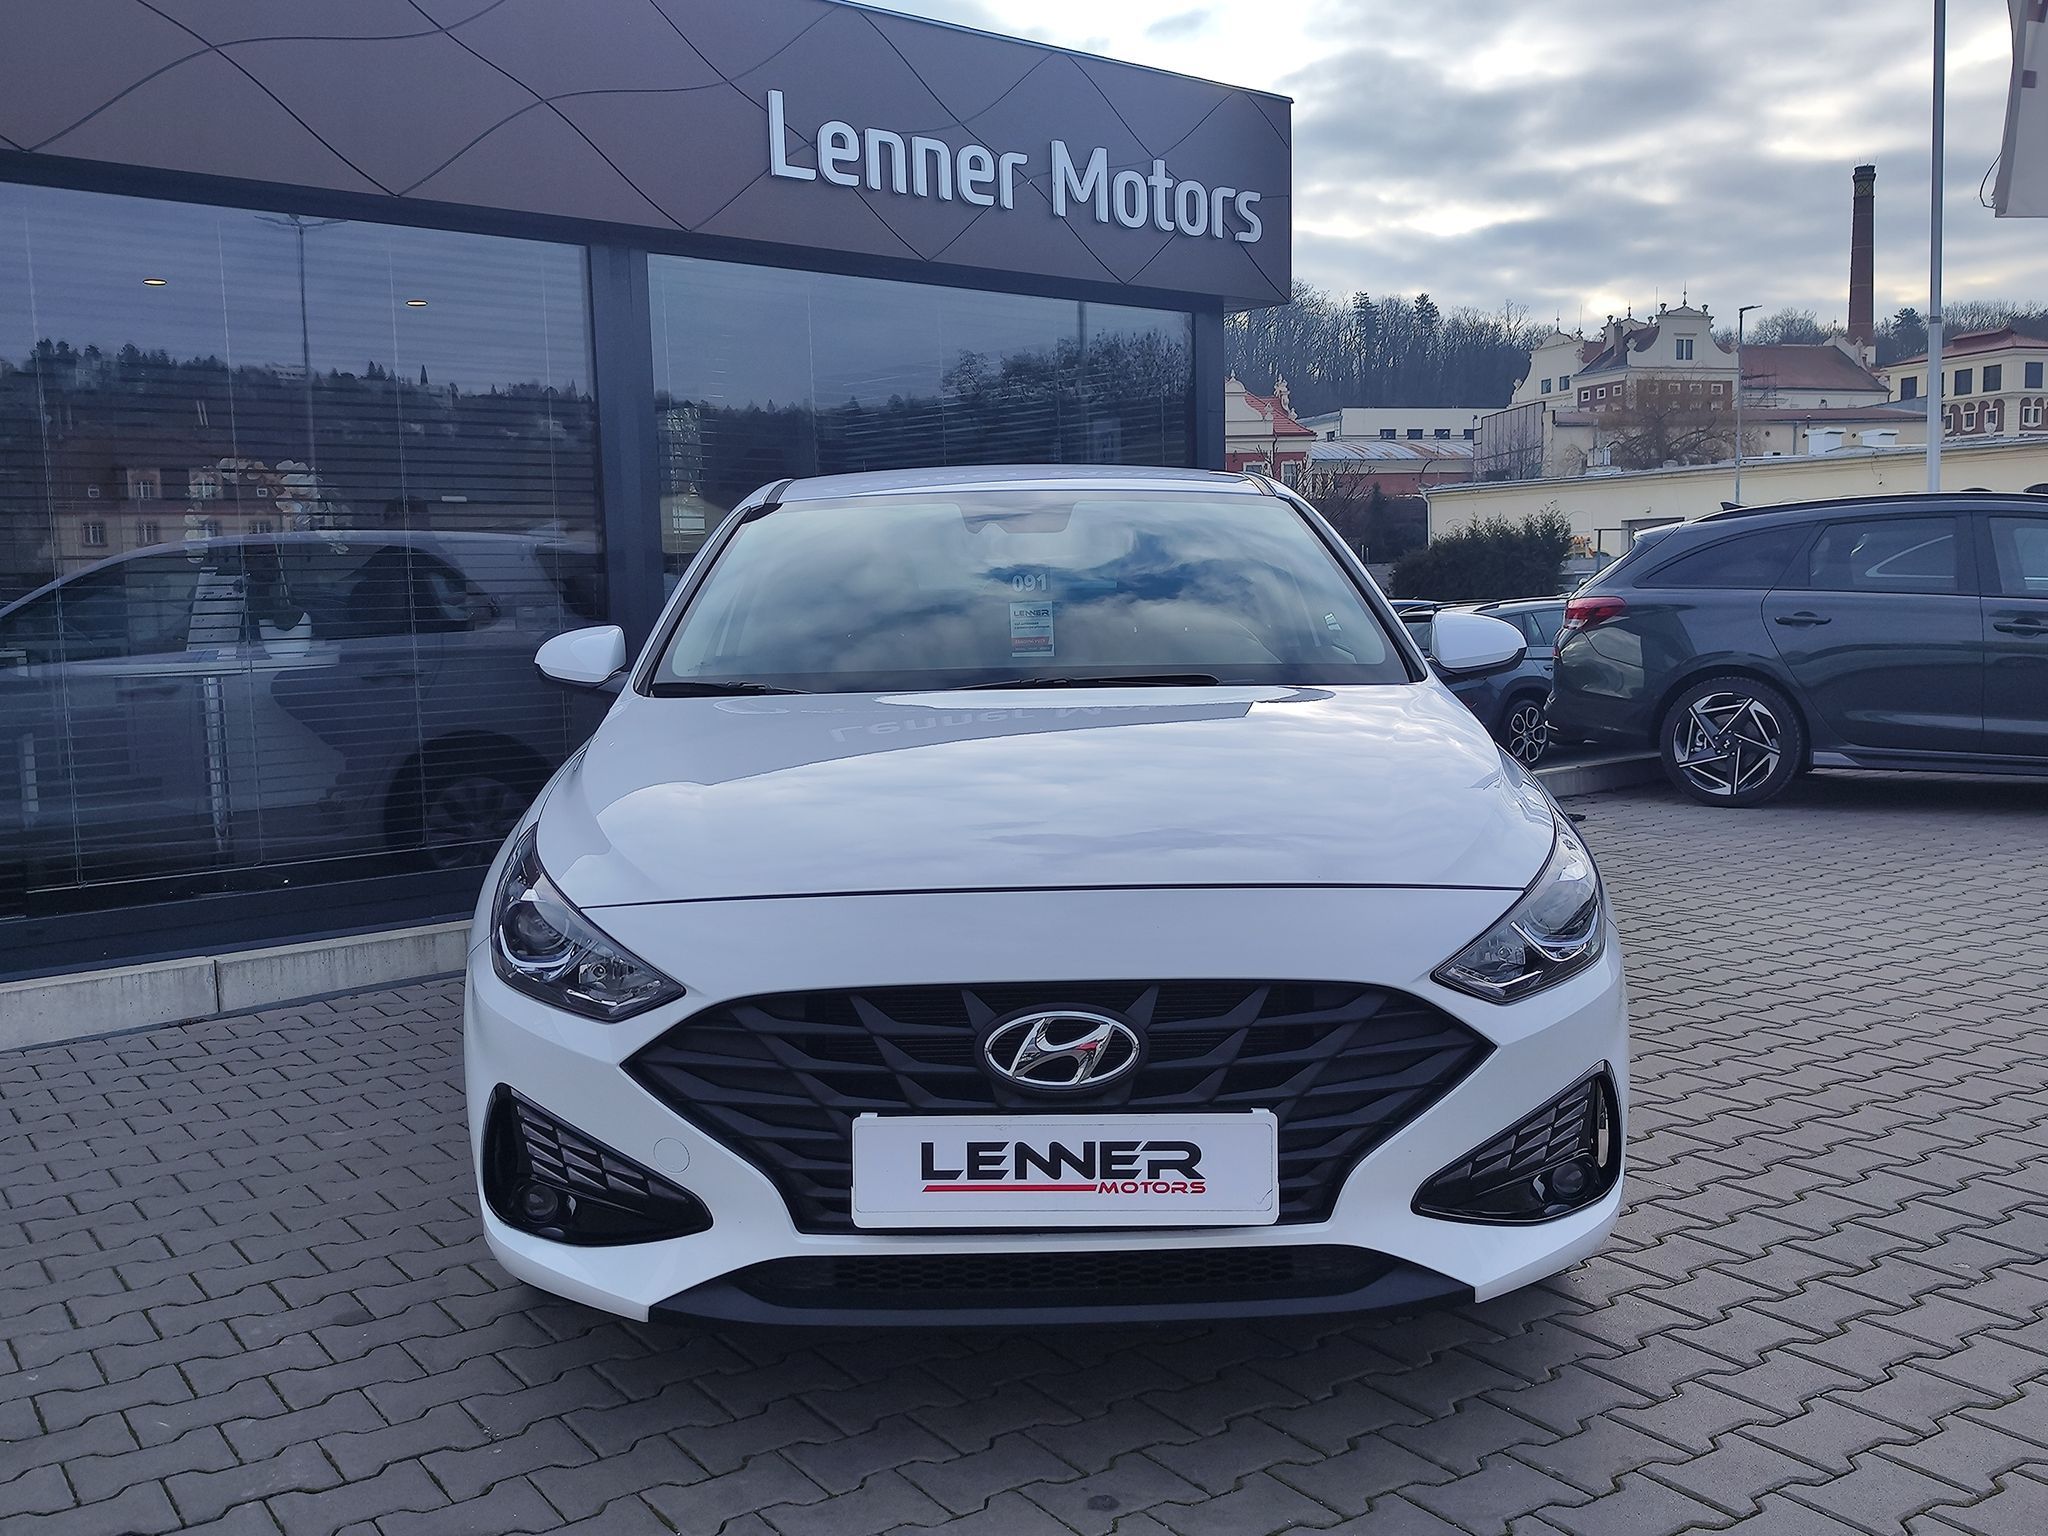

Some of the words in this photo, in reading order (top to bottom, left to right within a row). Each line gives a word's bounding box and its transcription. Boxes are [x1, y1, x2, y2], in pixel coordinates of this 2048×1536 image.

[767, 89, 1029, 210] Lenner
[1050, 139, 1264, 243] Motors
[1012, 573, 1048, 592] 091
[920, 1141, 1206, 1181] LENNER
[1098, 1181, 1206, 1194] MOTORS
